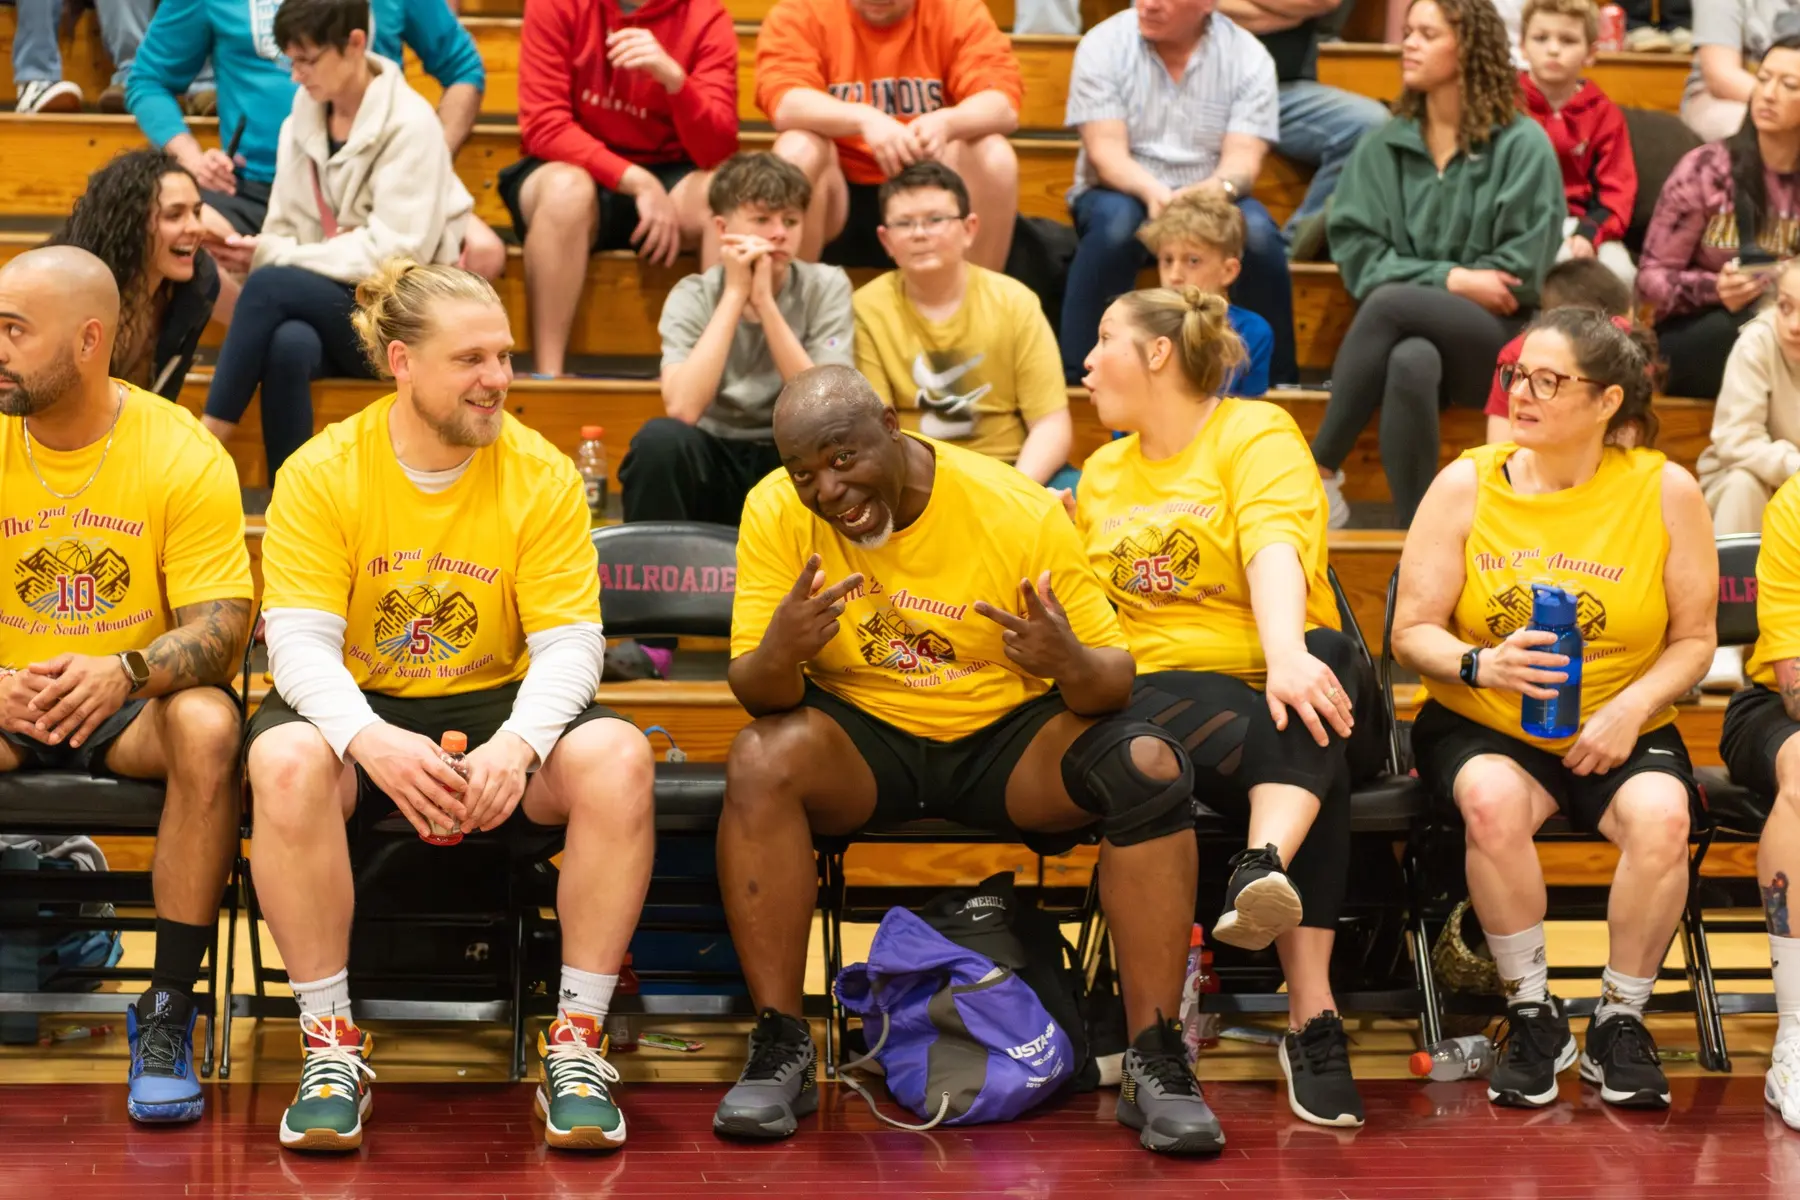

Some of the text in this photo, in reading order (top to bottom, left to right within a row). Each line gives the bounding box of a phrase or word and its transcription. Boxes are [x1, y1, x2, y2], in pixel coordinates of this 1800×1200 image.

[827, 77, 943, 115] INOIS
[0, 505, 145, 538] The 2nd Annual
[366, 549, 500, 584] Th 2nd Annual
[1132, 554, 1174, 594] 35
[1475, 548, 1625, 582] The 2nd Annual
[55, 574, 96, 613] 10
[889, 588, 968, 621] Annual
[28, 619, 51, 636] for
[54, 622, 90, 636] South
[94, 608, 154, 634] Mountain
[410, 617, 434, 656] 5
[369, 661, 393, 676] for
[395, 665, 432, 679] South
[436, 652, 495, 678] Mountain
[903, 674, 942, 689] South
[1005, 1034, 1049, 1059] USTA
